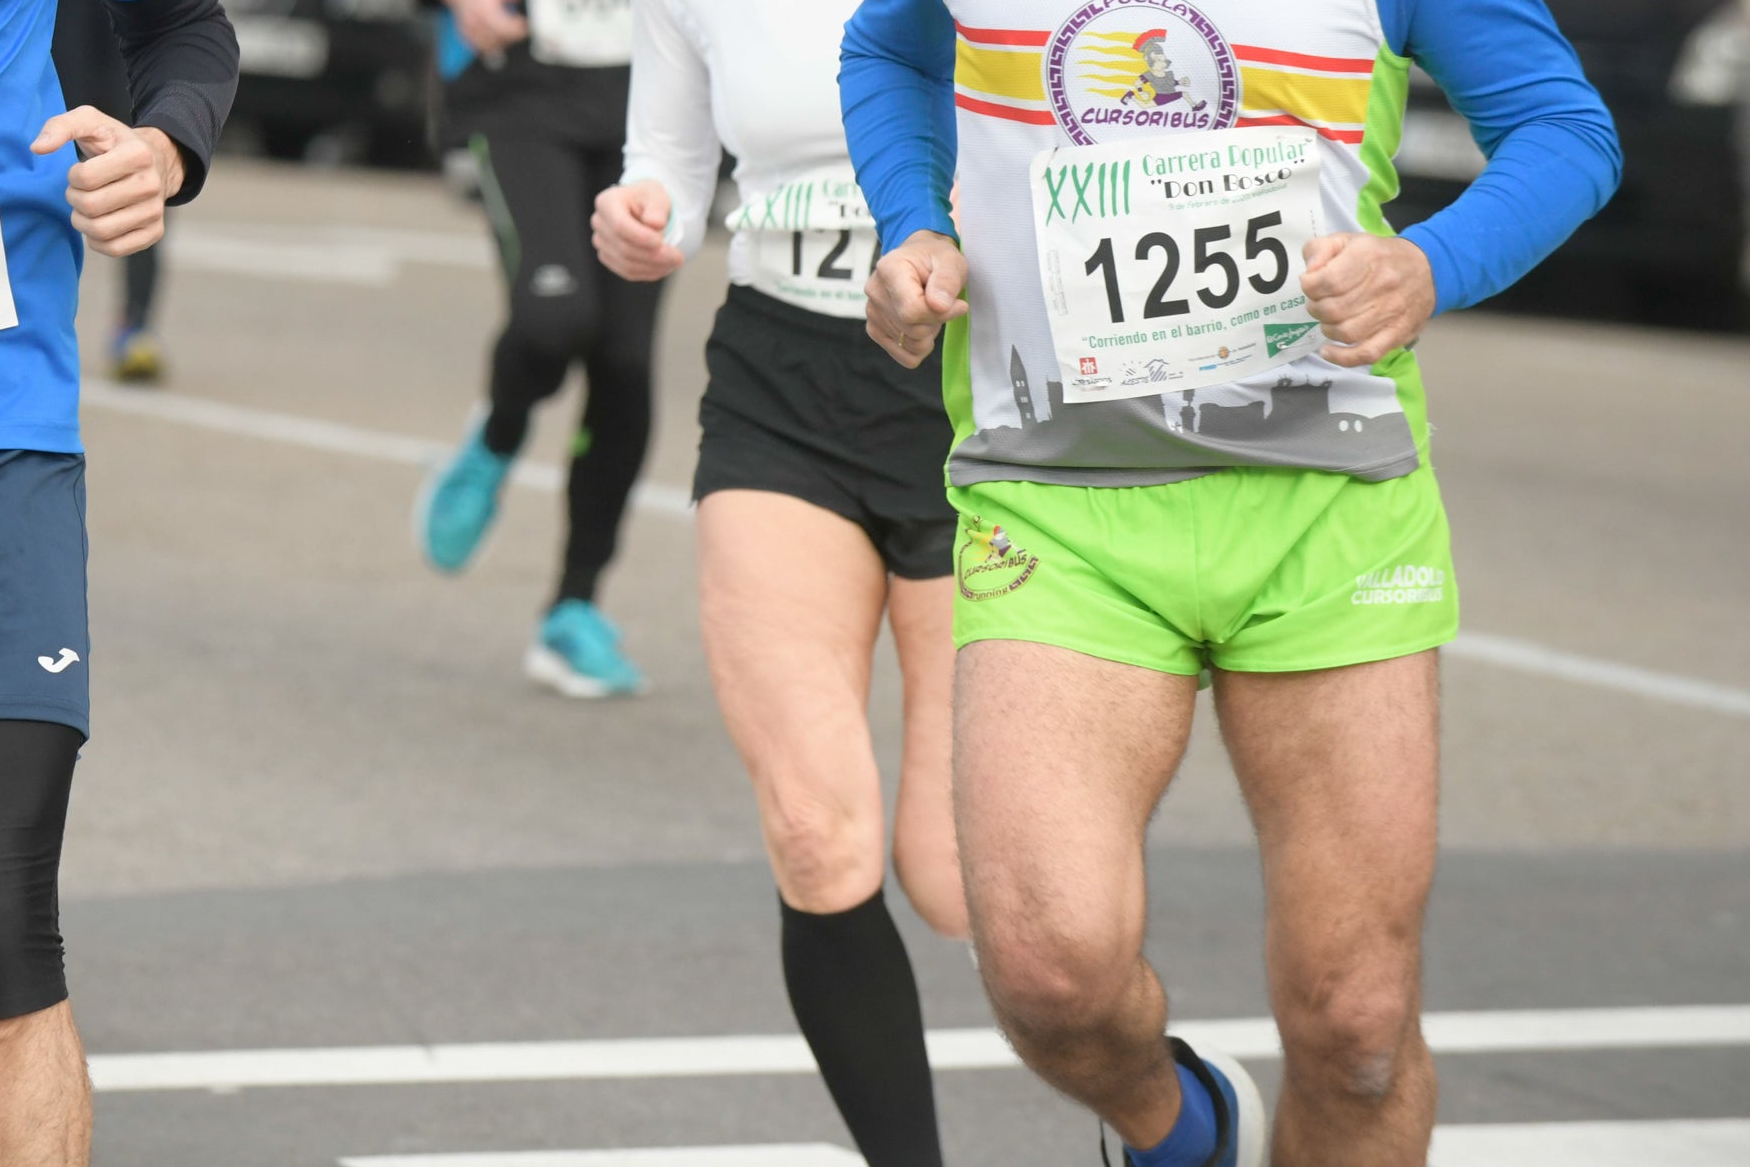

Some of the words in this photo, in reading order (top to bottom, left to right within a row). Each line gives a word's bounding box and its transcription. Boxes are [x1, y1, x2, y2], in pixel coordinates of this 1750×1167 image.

[1081, 107, 1210, 129] CURSORIBUS
[1045, 160, 1131, 227] XXIII
[1142, 149, 1222, 177] Carrera
[1228, 140, 1308, 174] Popular
[1150, 179, 1214, 200] "Don
[792, 229, 882, 280] 12
[1085, 210, 1289, 323] 1255
[1152, 330, 1167, 342] en
[1171, 326, 1182, 339] el
[1230, 309, 1259, 327] como
[1264, 304, 1277, 316] en
